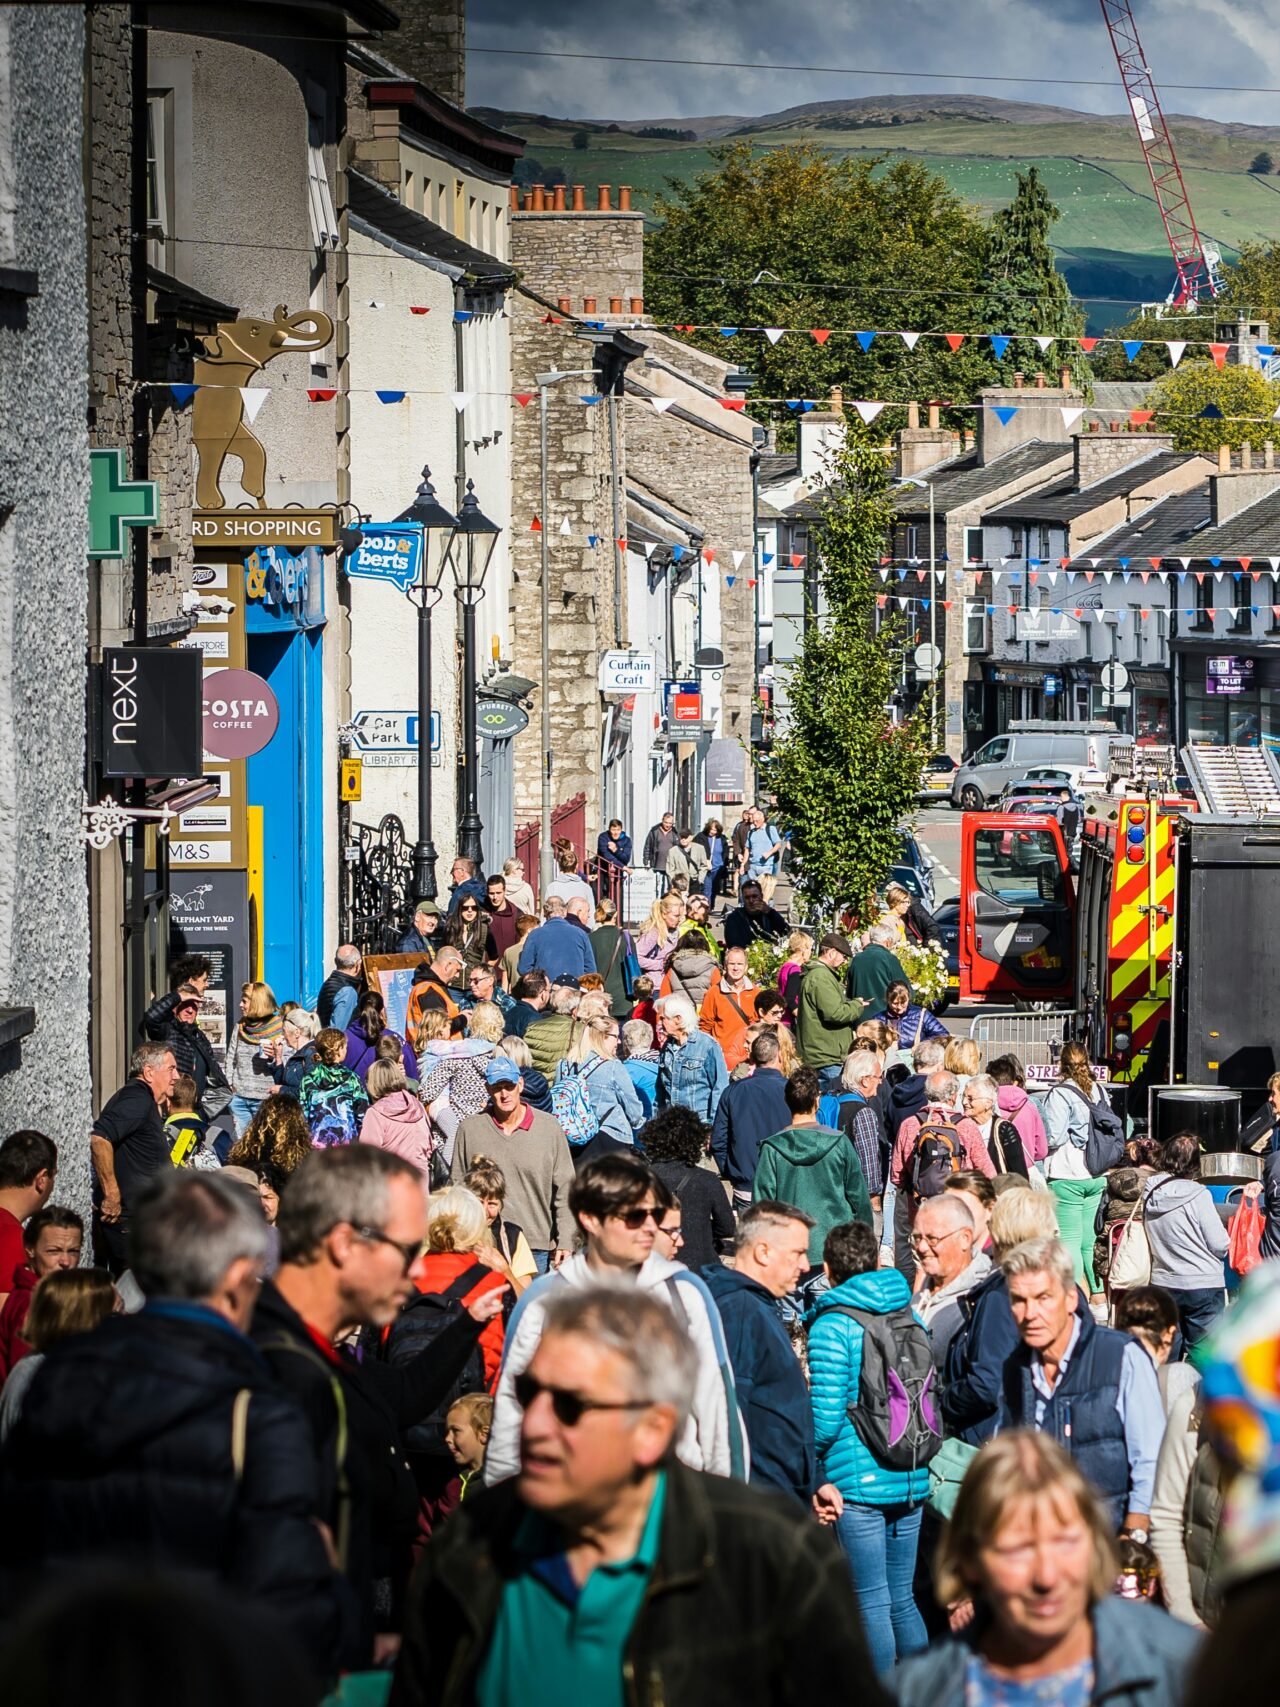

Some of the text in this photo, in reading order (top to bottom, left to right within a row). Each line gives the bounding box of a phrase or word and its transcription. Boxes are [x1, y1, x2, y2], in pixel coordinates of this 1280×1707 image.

[224, 520, 322, 536] SHOPPING
[358, 549, 409, 570] berts
[200, 641, 227, 651] STORE
[608, 659, 651, 671] Curtain
[615, 673, 643, 685] Craft
[111, 657, 138, 744] next
[202, 700, 269, 718] COSTA
[213, 721, 253, 729] COFFEE
[374, 718, 398, 730] Car
[371, 732, 401, 743] Park
[364, 756, 438, 765] LIBRARY RD
[168, 844, 210, 860] M&S
[171, 915, 235, 923] ELEPHANT YARD
[1027, 1065, 1059, 1078] STRE
